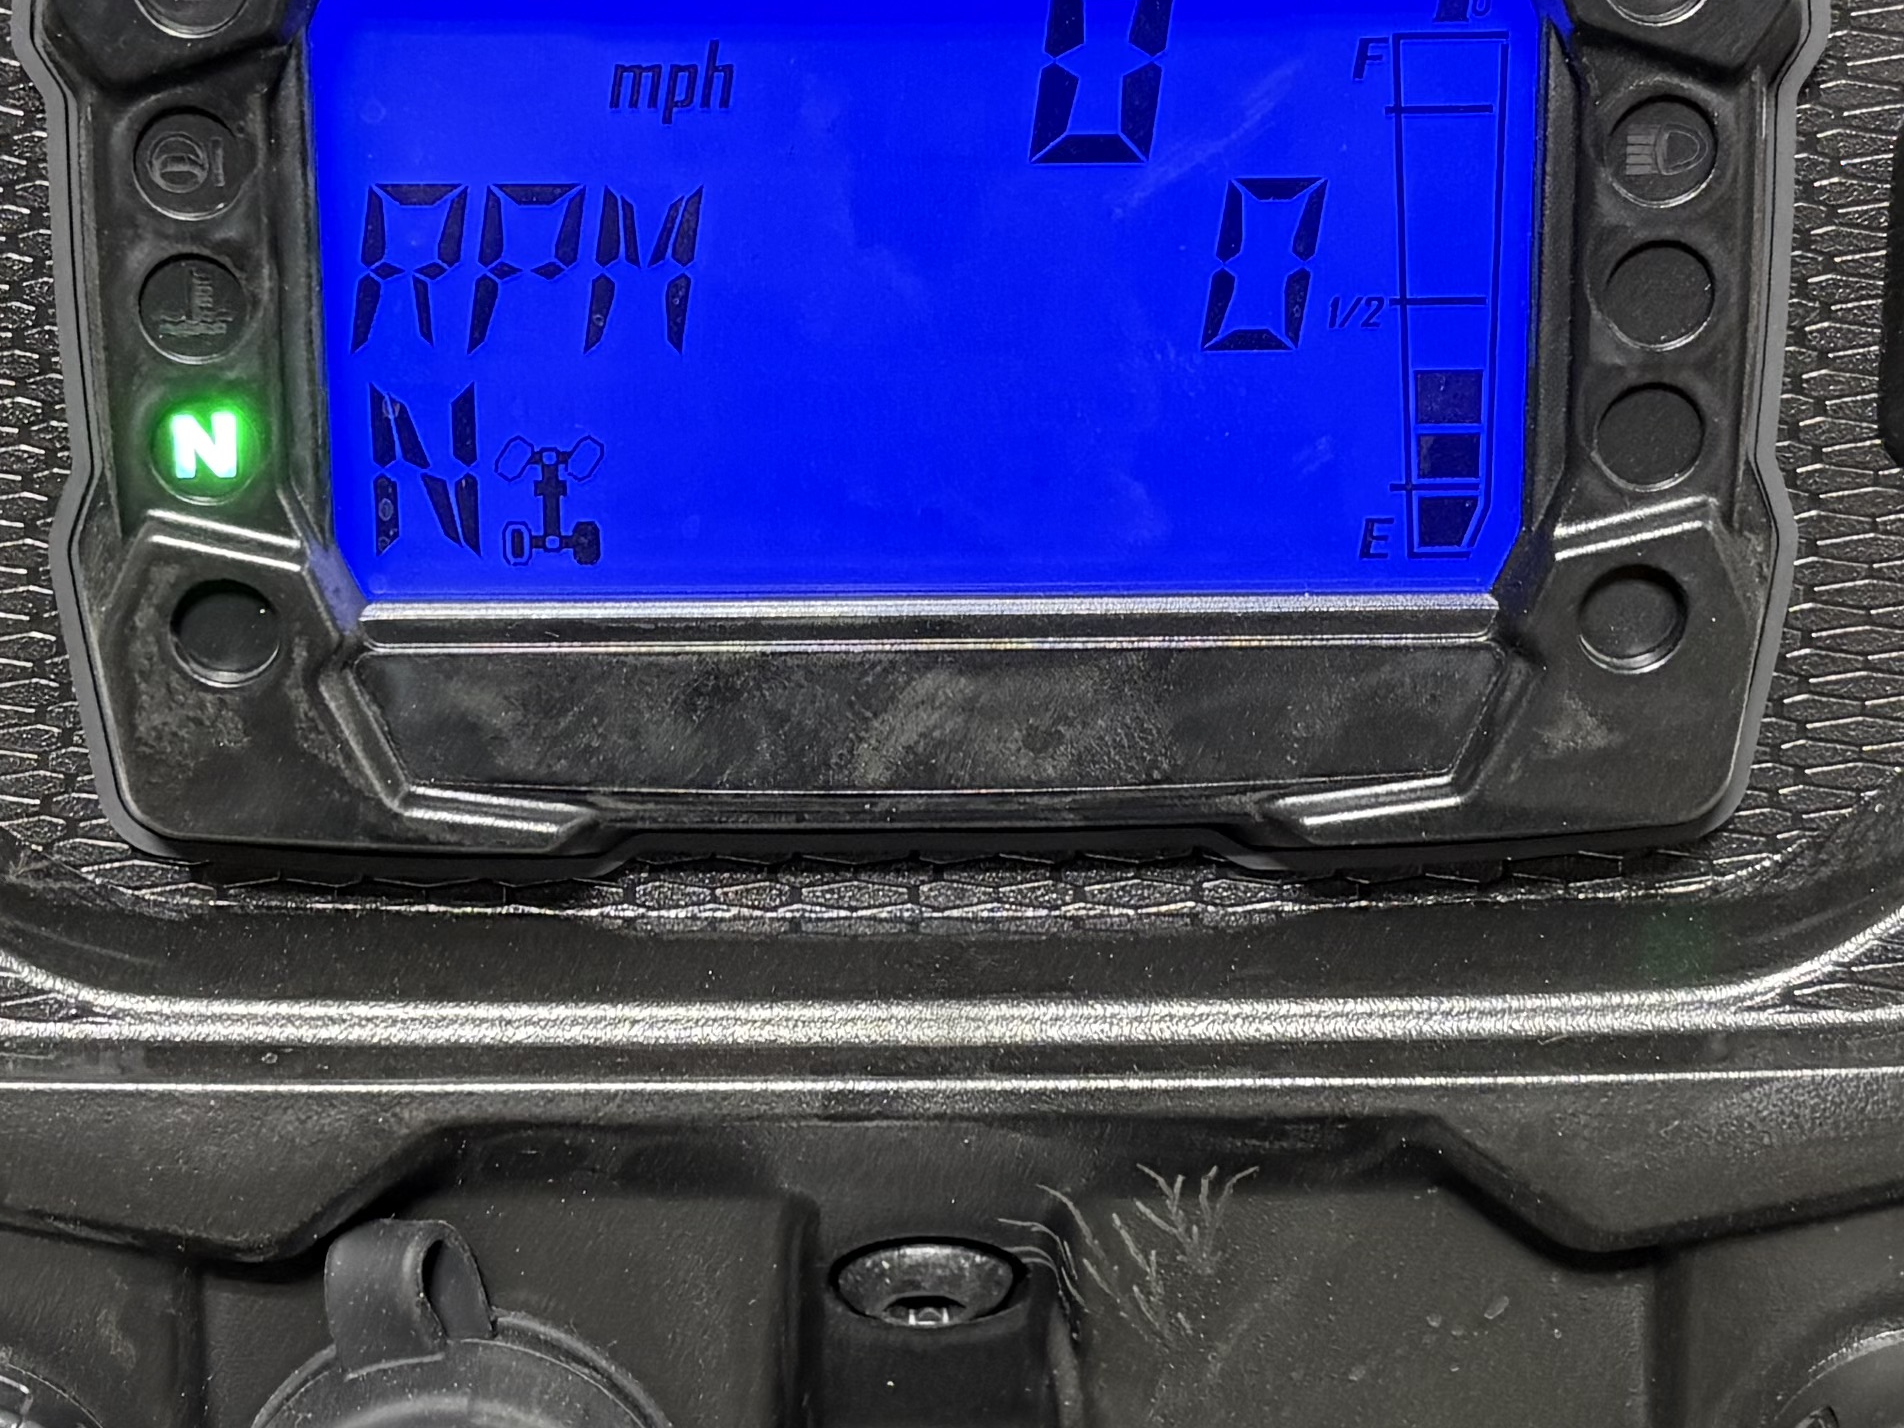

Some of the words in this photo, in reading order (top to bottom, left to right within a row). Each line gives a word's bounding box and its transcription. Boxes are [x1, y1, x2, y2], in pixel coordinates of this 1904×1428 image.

[609, 39, 735, 125] mph
[1353, 36, 1389, 82] F
[351, 180, 703, 355] RPM
[1201, 176, 1327, 353] 0
[1327, 294, 1386, 329] 1/2
[172, 410, 237, 481] N
[366, 382, 483, 557] N
[1359, 516, 1392, 559] E
